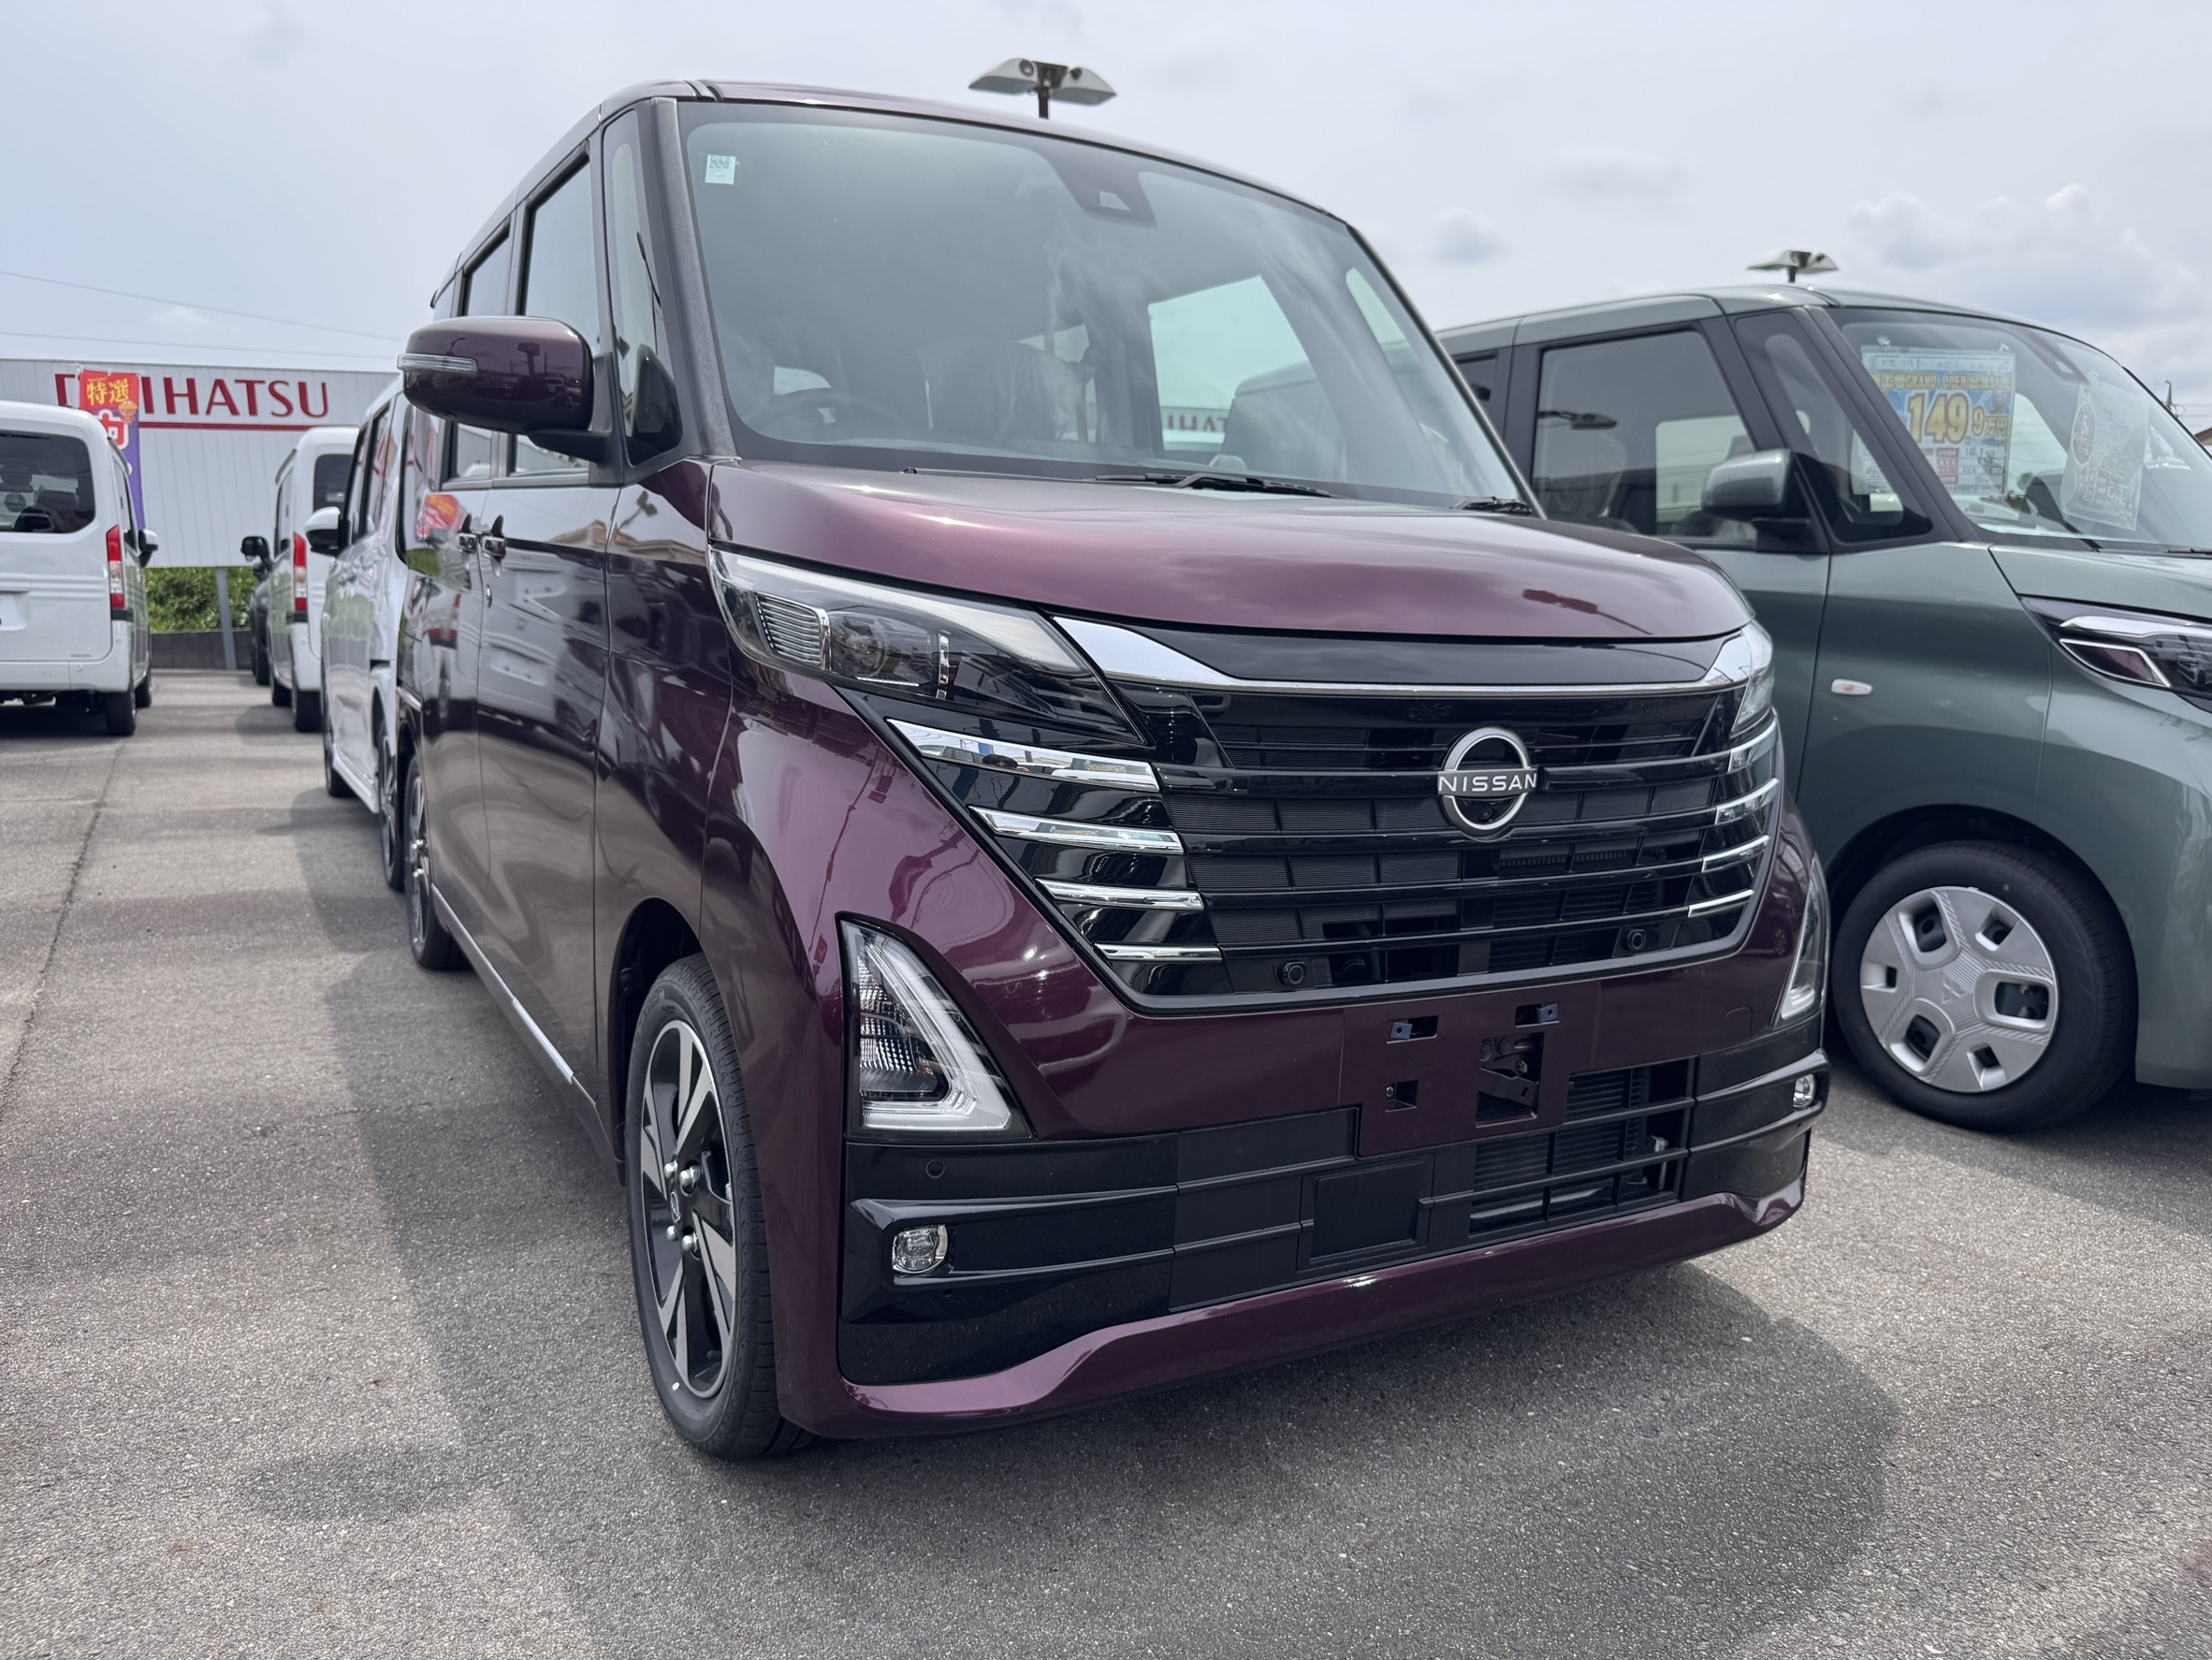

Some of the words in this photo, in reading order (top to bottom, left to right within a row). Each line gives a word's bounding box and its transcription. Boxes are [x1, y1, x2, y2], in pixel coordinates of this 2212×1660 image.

[55, 373, 329, 418] DIHATSU
[86, 378, 129, 406] 特選
[1438, 773, 1536, 792] NISSAN
